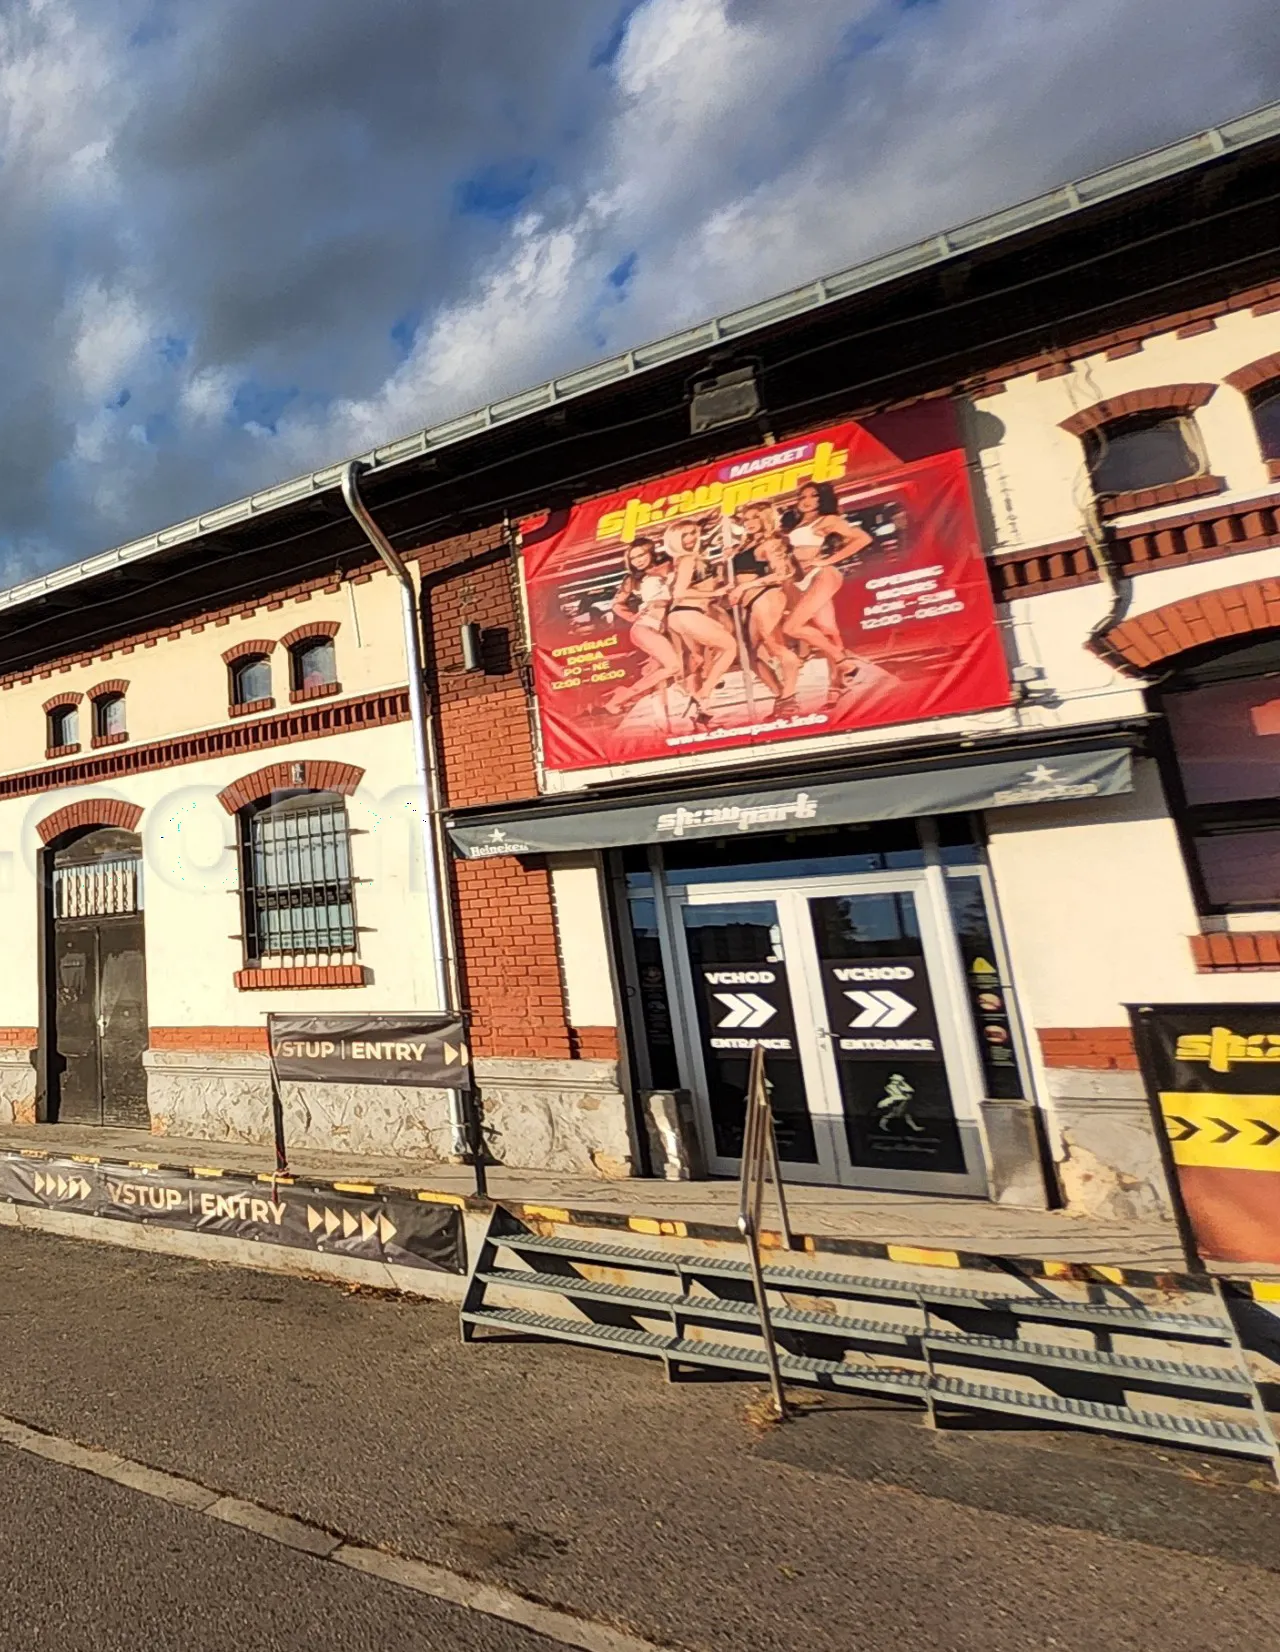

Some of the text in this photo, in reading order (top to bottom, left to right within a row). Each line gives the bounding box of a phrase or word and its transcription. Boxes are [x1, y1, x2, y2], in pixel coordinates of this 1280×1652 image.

[729, 444, 810, 480] MARKET
[551, 634, 618, 657] OTEVÍRACÍ
[566, 651, 605, 666] DOBA
[563, 666, 582, 677] PO
[591, 661, 611, 672] NE
[551, 677, 582, 690] 12:00
[666, 713, 829, 746] www.showpark.info
[469, 843, 530, 858] Heineken
[705, 971, 777, 985] VCHOD
[833, 966, 915, 982] VCHOD
[351, 1042, 427, 1062] ENTRY
[710, 1038, 793, 1050] ENTRANCE
[840, 1038, 936, 1051] ENTRANCE
[107, 1182, 182, 1211] VSTUP
[200, 1192, 287, 1226] ENTRY
